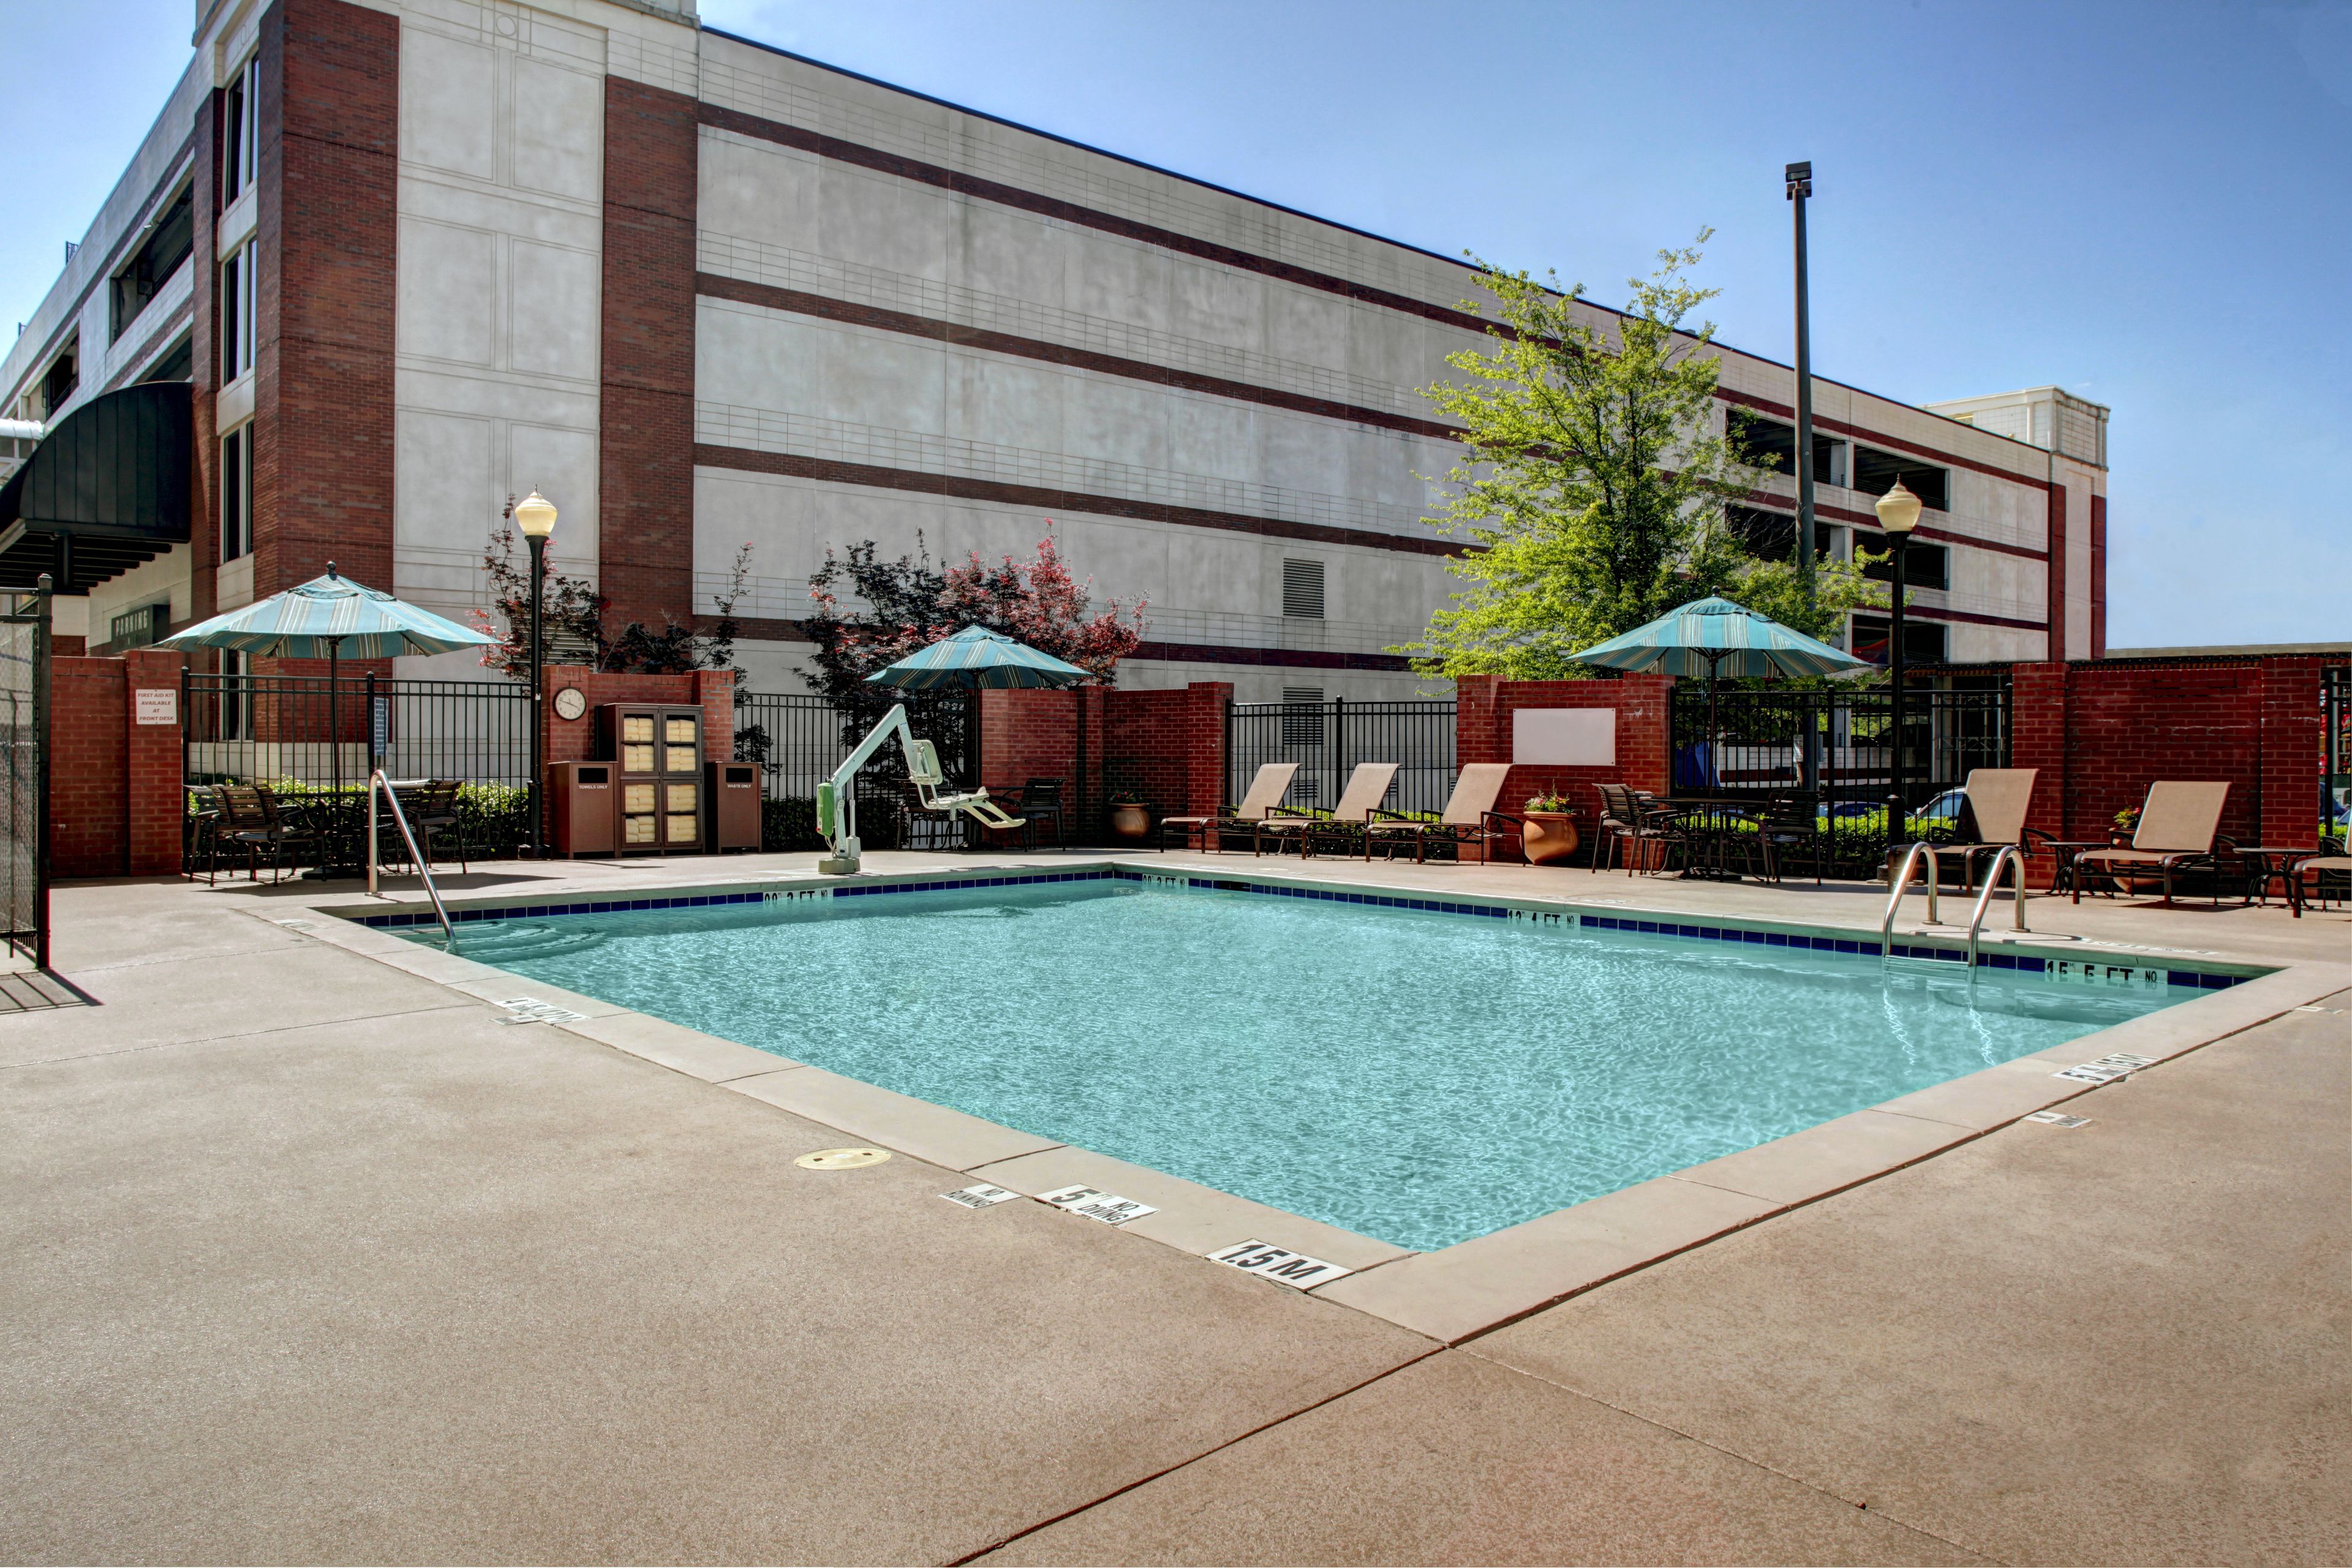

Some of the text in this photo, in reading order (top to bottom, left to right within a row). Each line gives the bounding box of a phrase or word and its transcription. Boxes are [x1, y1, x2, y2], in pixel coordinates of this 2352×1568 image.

[116, 610, 147, 636] PARKING
[1567, 914, 1575, 925] NO
[2144, 970, 2158, 983] NO
[978, 1188, 1006, 1197] NO
[1050, 1188, 1101, 1203] 5
[1076, 1204, 1129, 1222] DIVING
[1108, 1201, 1140, 1212] NO
[1218, 1244, 1329, 1280] 1.5 M
